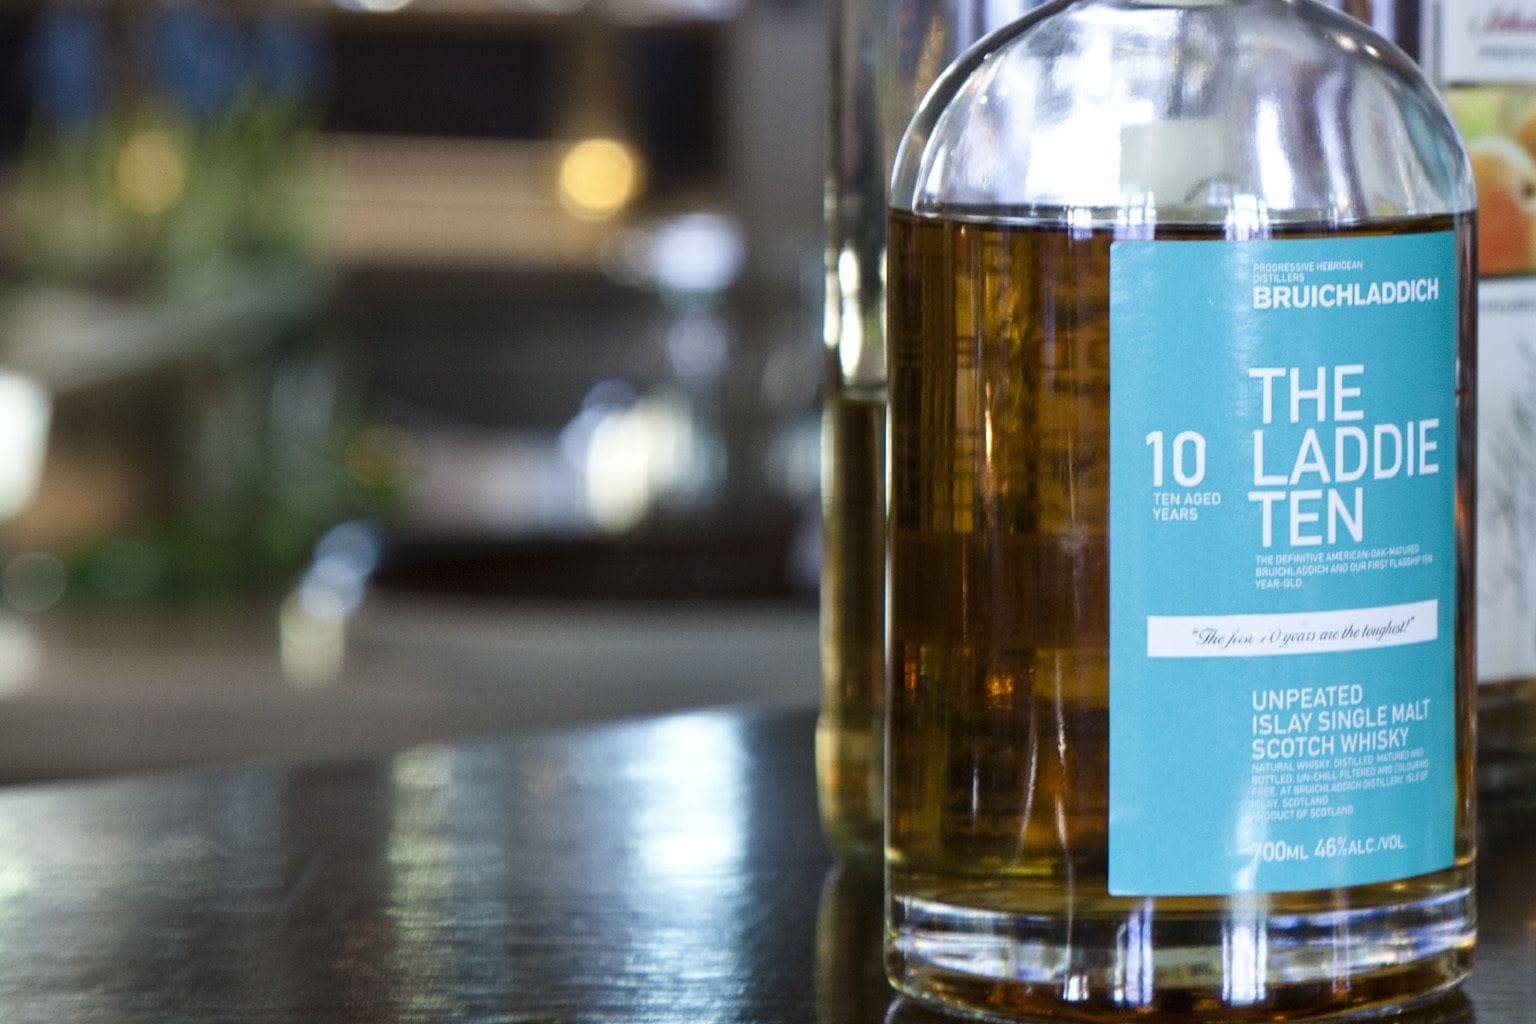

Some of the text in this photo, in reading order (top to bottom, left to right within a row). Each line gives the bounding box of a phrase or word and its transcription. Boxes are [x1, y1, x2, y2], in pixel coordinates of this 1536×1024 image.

[1253, 260, 1364, 273] PROGRESSIVE HEBRIDEAN
[1253, 272, 1305, 284] DISTILLERS
[1253, 277, 1439, 309] BRUICHLADDICH
[1248, 364, 1364, 424] THE
[1146, 430, 1206, 488] 10
[1253, 418, 1439, 486] LADDIE
[1153, 492, 1221, 506] TEN AGED
[1152, 507, 1199, 521] YEARS
[1248, 487, 1363, 547] TEN
[1255, 564, 1329, 577] BRUICHLADDICH
[1330, 563, 1348, 574] AND
[1350, 561, 1366, 572] OUR
[1368, 559, 1388, 571] FIRST
[1389, 555, 1421, 569] FLAGSHIP
[1256, 554, 1273, 565] THE
[1275, 552, 1324, 565] DEFINITIVE
[1255, 577, 1303, 589] YEAR-OLD
[1280, 631, 1316, 647] years
[1319, 630, 1340, 640] are
[1341, 623, 1360, 639] the
[1252, 684, 1363, 711] UNPEATED
[1252, 698, 1431, 736] ISLAY SINGLE MALT
[1251, 727, 1410, 760] SCOTCH WHISKY
[1251, 761, 1294, 773] NATURAL
[1376, 749, 1409, 762] MATURED
[1251, 774, 1293, 785] BOTTLED
[1339, 767, 1376, 780] FILTERED
[1377, 764, 1392, 775] AND
[1280, 785, 1292, 795] AT
[1293, 780, 1361, 795] BRUICHLADDICH
[1282, 795, 1329, 808] SCOTLAND
[1296, 808, 1309, 820] OF
[1310, 804, 1355, 819] SCOTLAND
